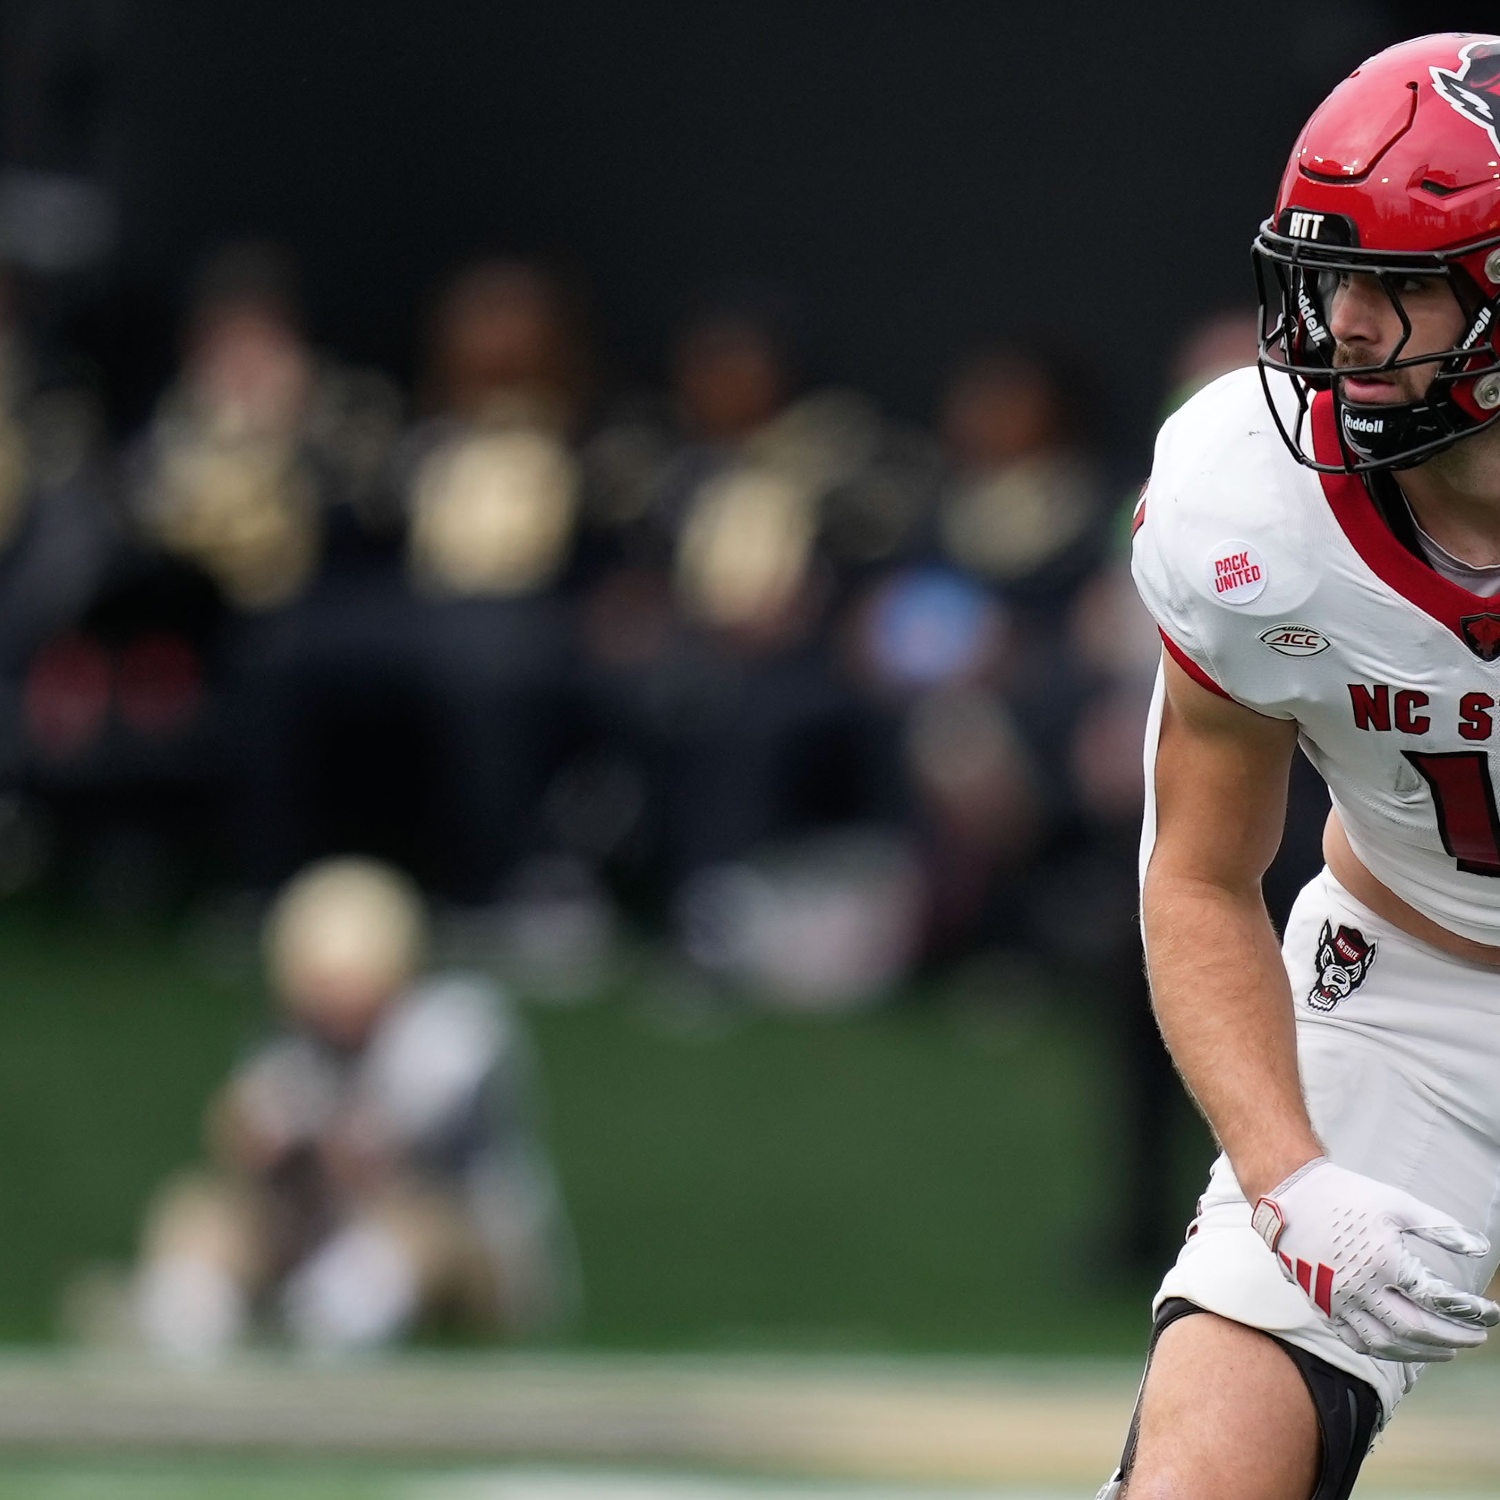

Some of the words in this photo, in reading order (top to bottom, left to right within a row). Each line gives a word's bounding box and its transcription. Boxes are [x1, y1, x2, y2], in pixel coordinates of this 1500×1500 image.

[1289, 211, 1324, 239] HTT
[1345, 414, 1384, 433] Riddell
[1215, 551, 1249, 576] PACK
[1215, 565, 1261, 593] UNITED
[1271, 633, 1321, 646] ACC
[1347, 684, 1431, 735] NC
[1342, 944, 1359, 960] STATE
